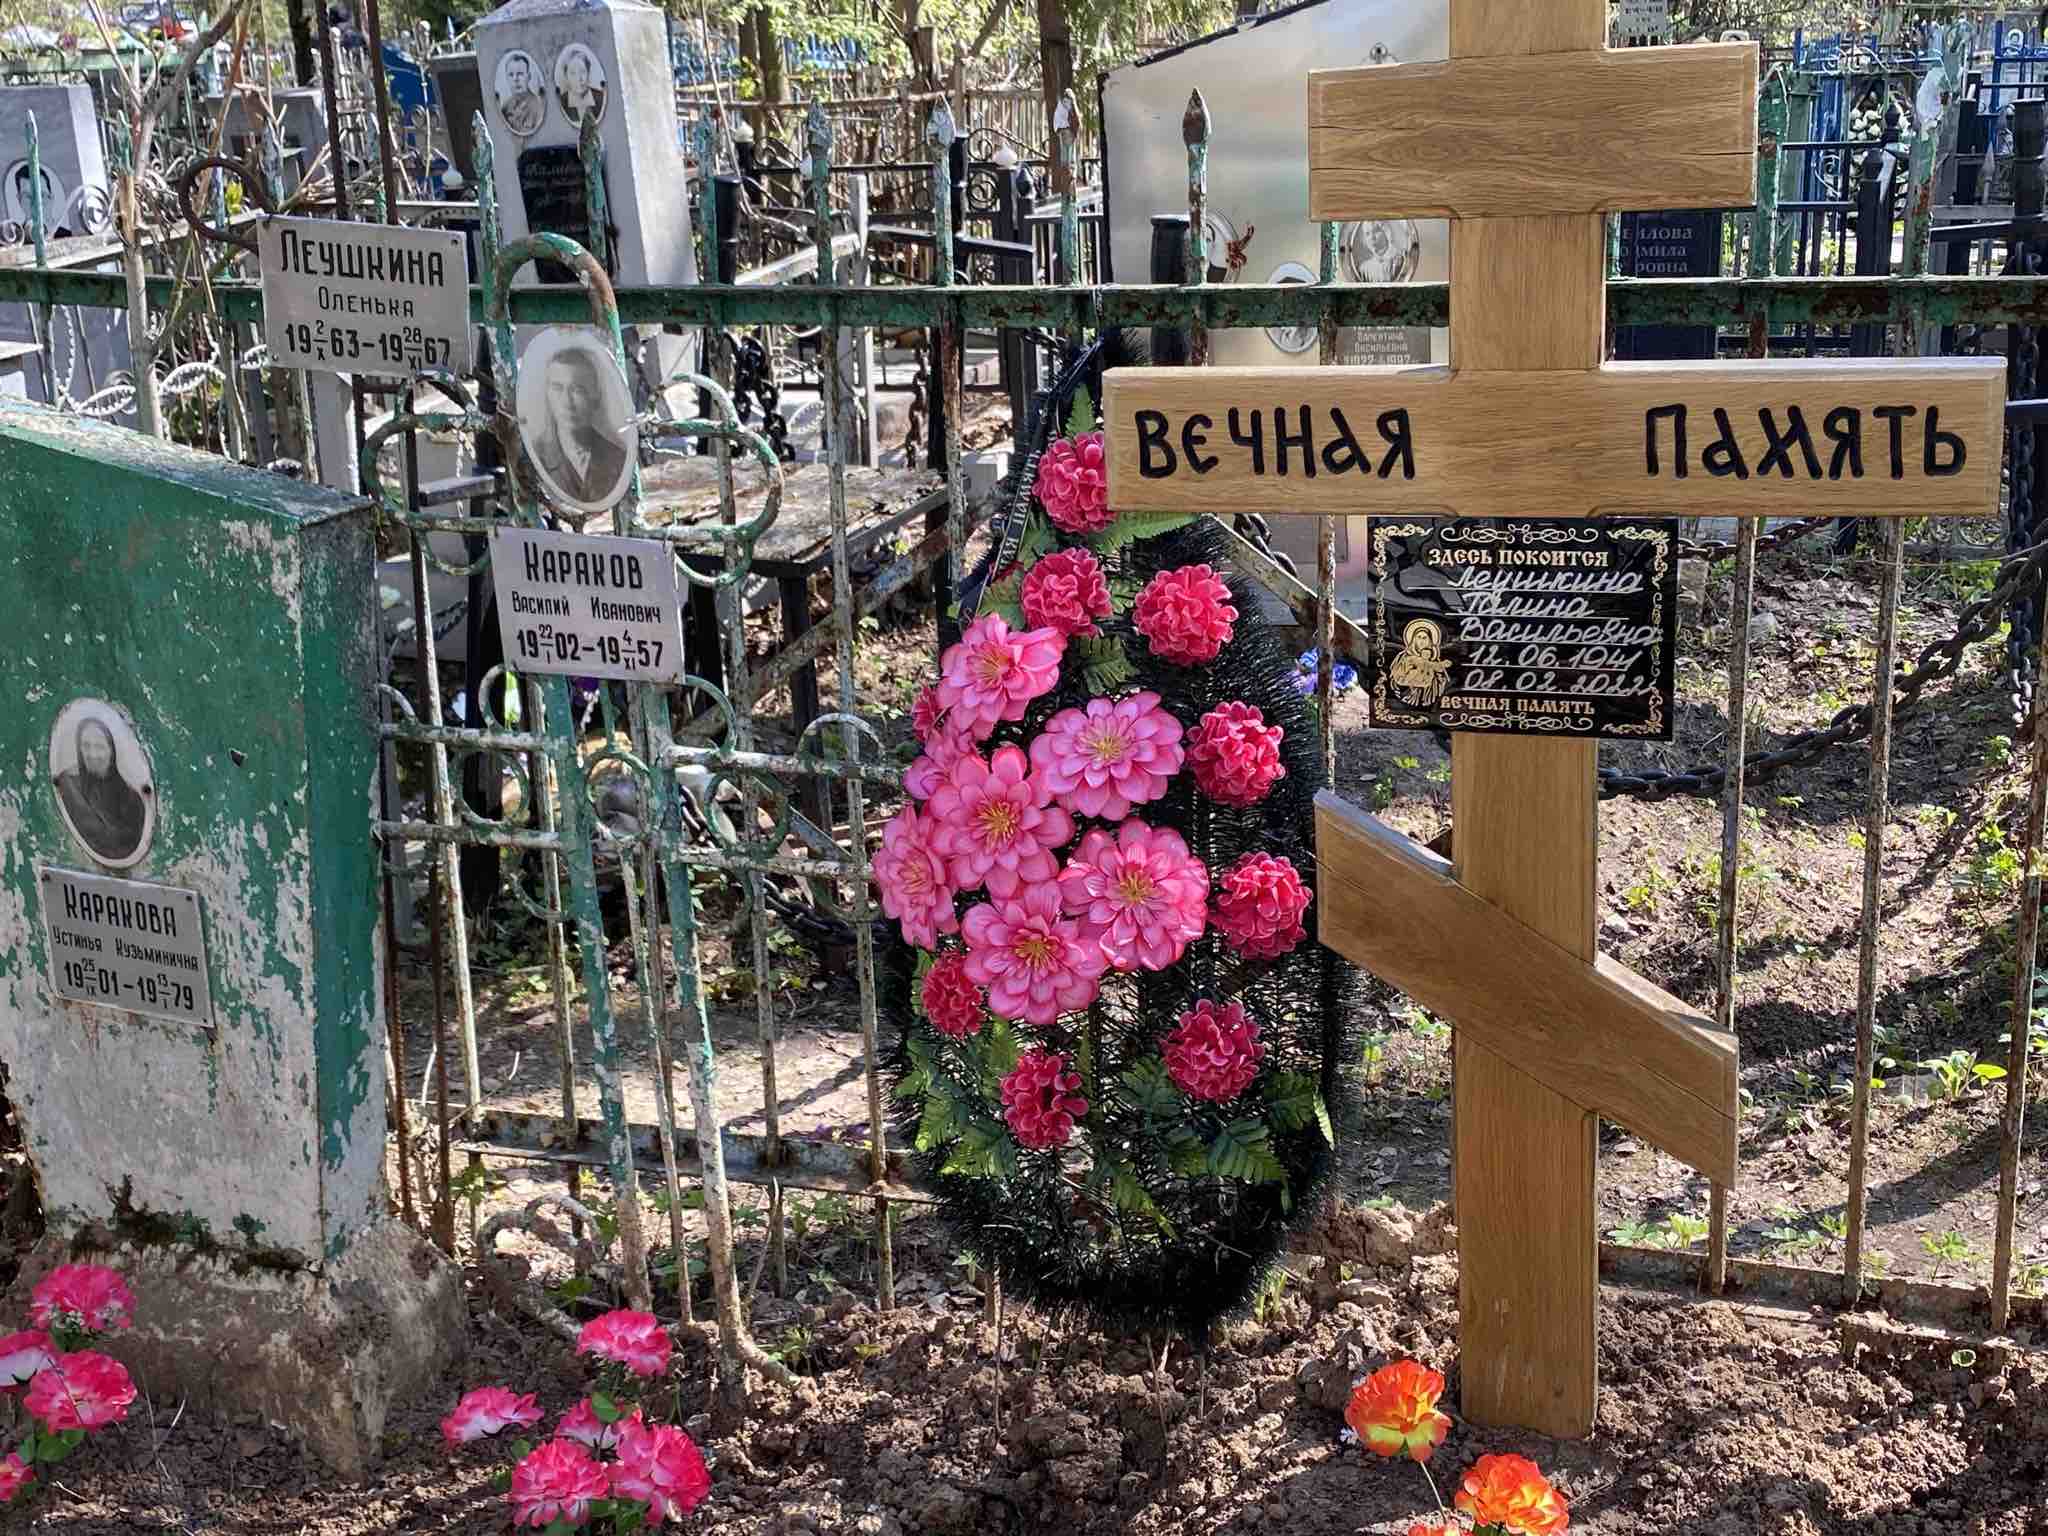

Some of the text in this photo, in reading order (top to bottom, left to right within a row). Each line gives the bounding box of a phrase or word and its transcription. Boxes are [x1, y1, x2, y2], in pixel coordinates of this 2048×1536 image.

[280, 229, 444, 287] ЛЕУШКИНА
[318, 286, 415, 318] ОЛЕНЬКА
[1135, 404, 1968, 481] ВЕЧНАЯ ПАМЯТЬ
[523, 541, 643, 589] КАРАКОВ
[1428, 549, 1609, 567] ЗДЕСЬ ПОКОИТСЯ
[1447, 565, 1645, 596] Леушкина
[511, 590, 663, 624] ВАСИЛИЙ ИВАНОВИЧ
[1457, 590, 1595, 617] Галина
[1440, 695, 1596, 715] ВЕЧНАЯ ПАМЯТЬ
[63, 883, 177, 937] КАРАКОВА
[52, 925, 200, 972] УСТИНЬЯ КУЗЬМИНИЧНА
